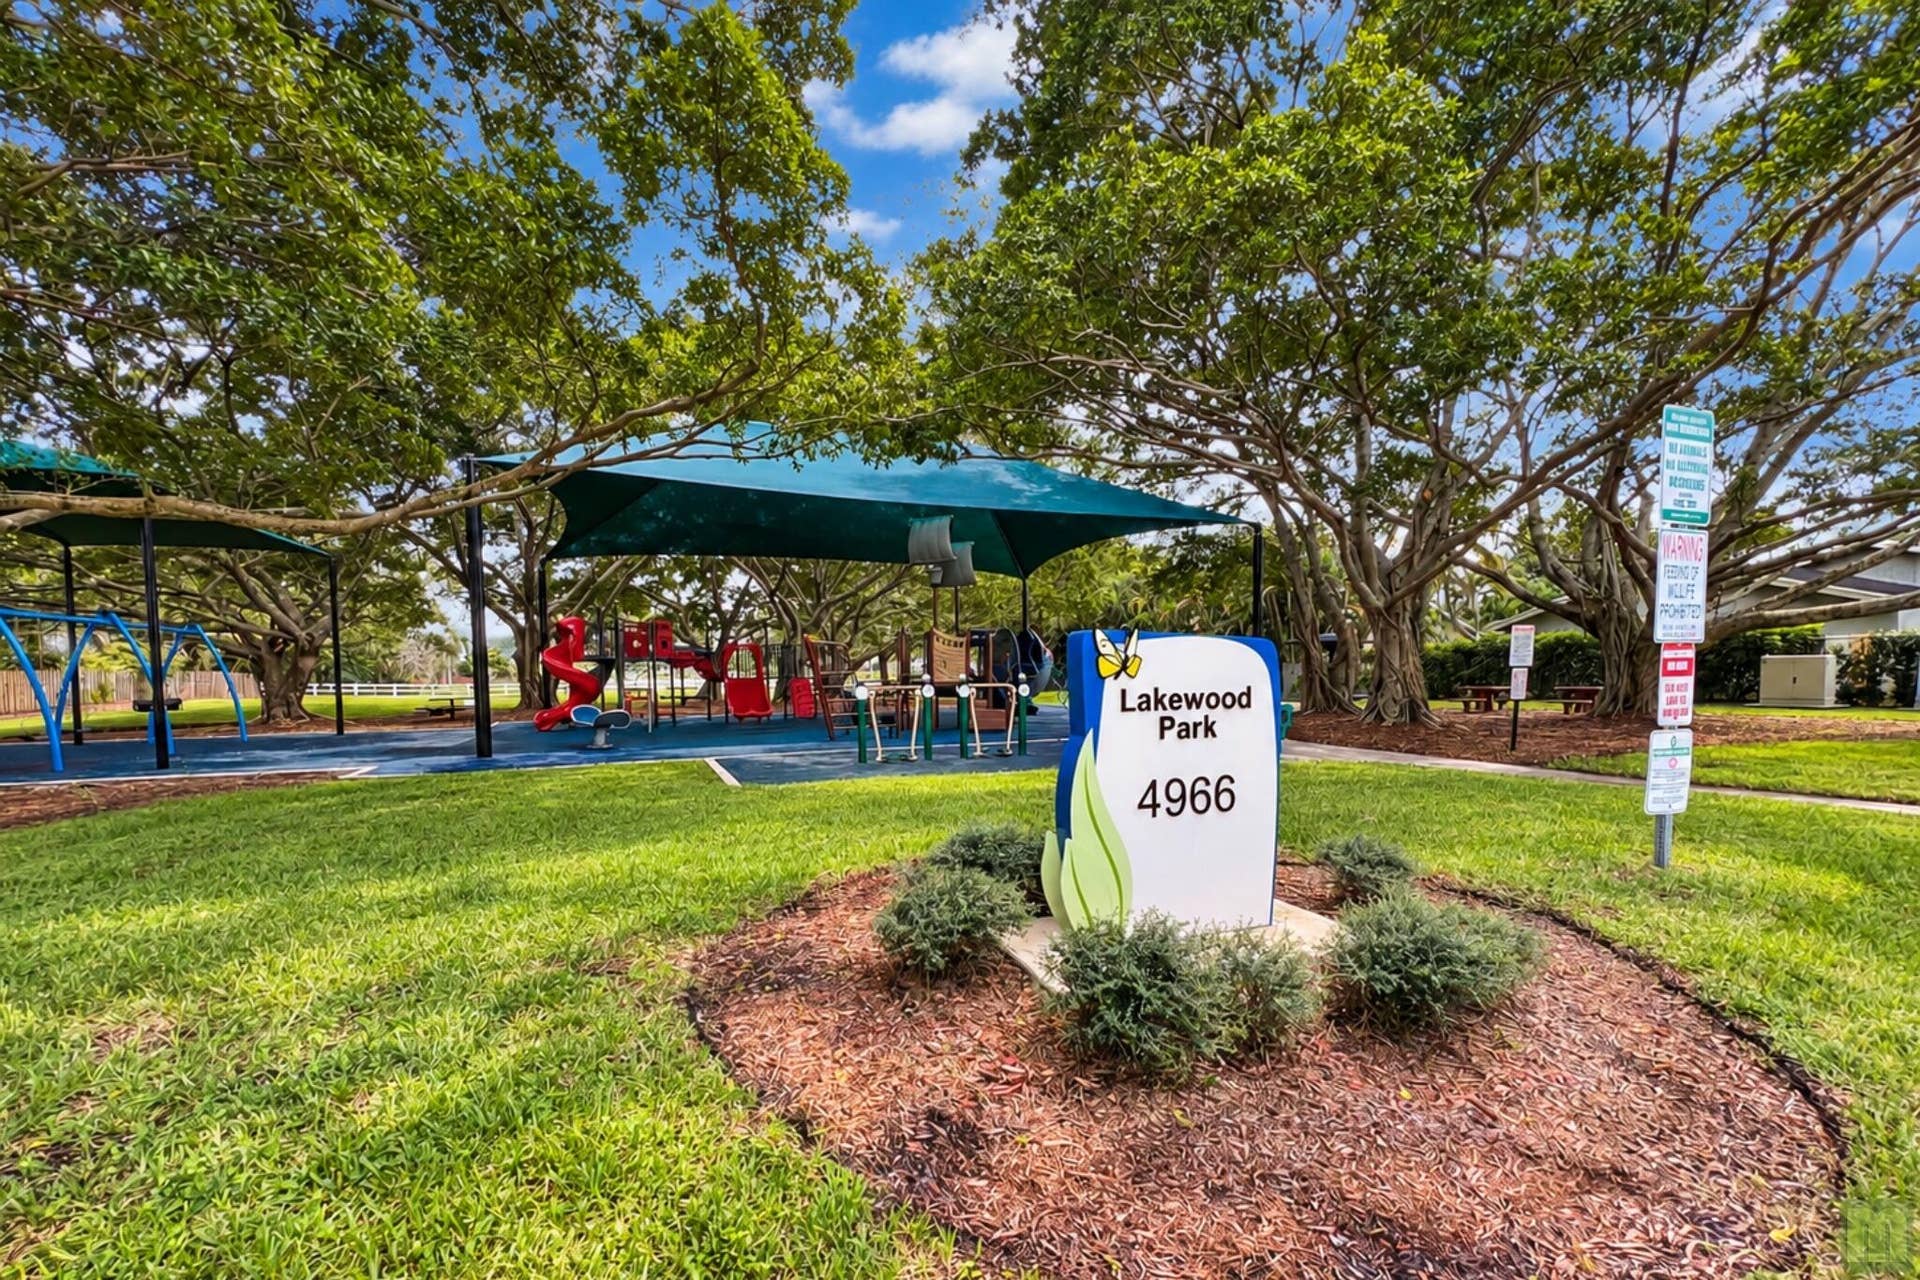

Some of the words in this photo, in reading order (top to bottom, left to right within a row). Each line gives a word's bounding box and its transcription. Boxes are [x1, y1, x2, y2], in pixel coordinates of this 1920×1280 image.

[1663, 535, 1703, 562] WARNING
[1120, 685, 1252, 713] Lakewood
[1159, 714, 1217, 740] Park
[1137, 774, 1236, 818] 4966
